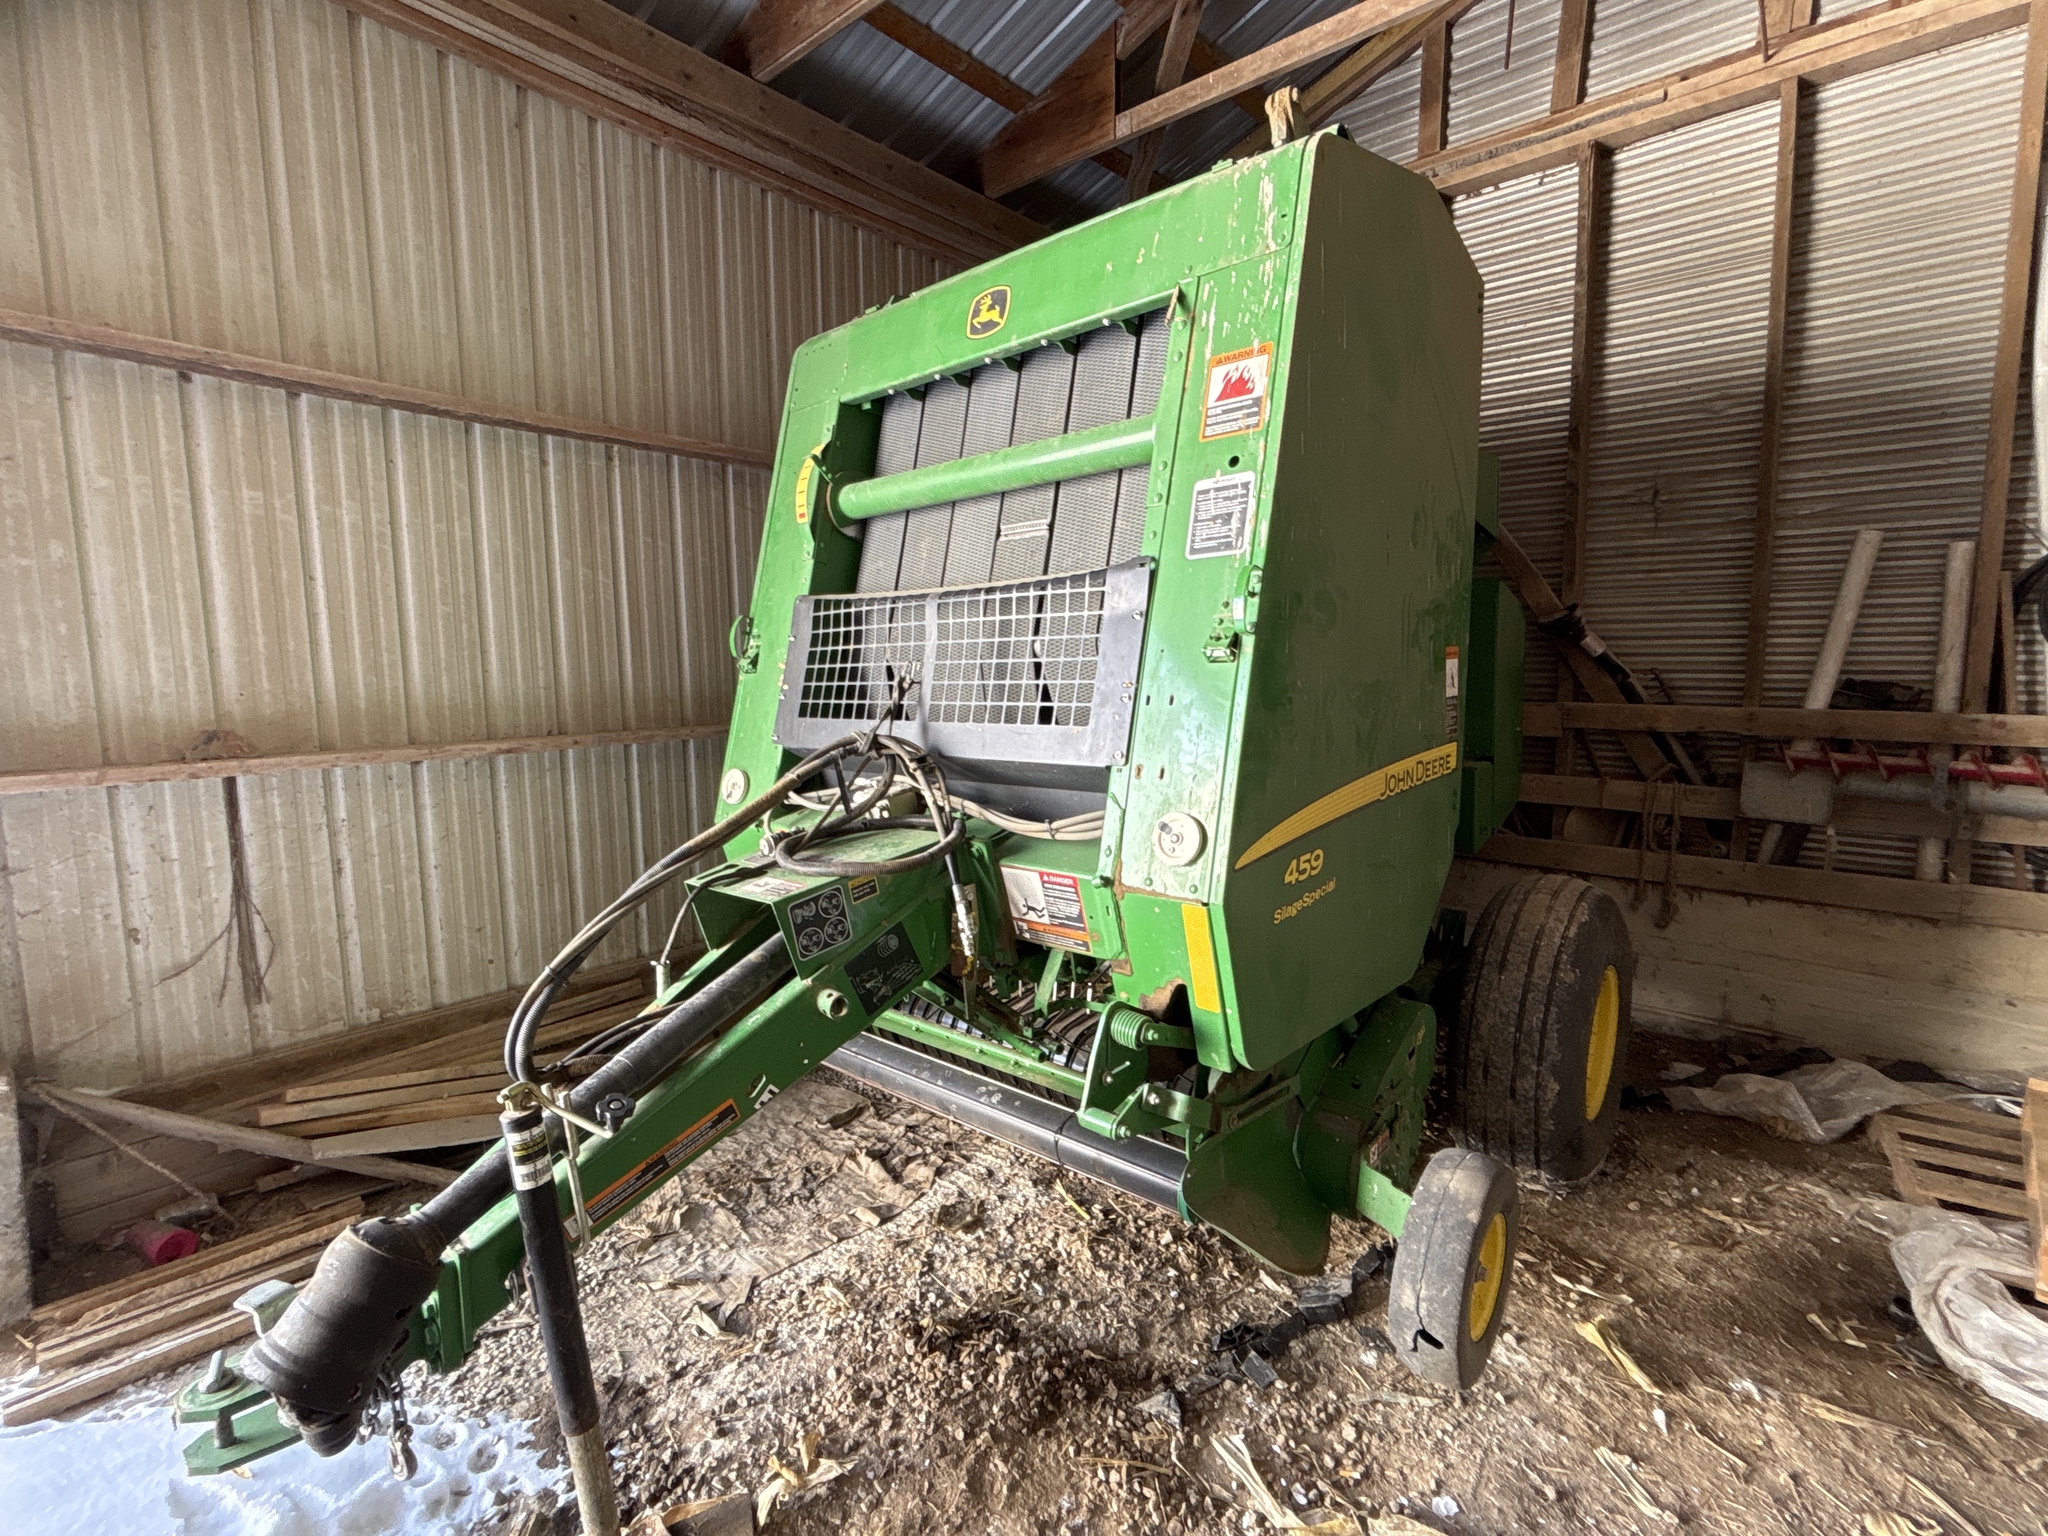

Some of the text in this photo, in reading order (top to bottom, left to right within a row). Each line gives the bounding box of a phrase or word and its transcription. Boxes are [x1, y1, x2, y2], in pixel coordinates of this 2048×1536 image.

[1049, 875, 1073, 885] DANGER
[1283, 848, 1324, 886] 459
[1273, 876, 1336, 925] SilageSpecial
